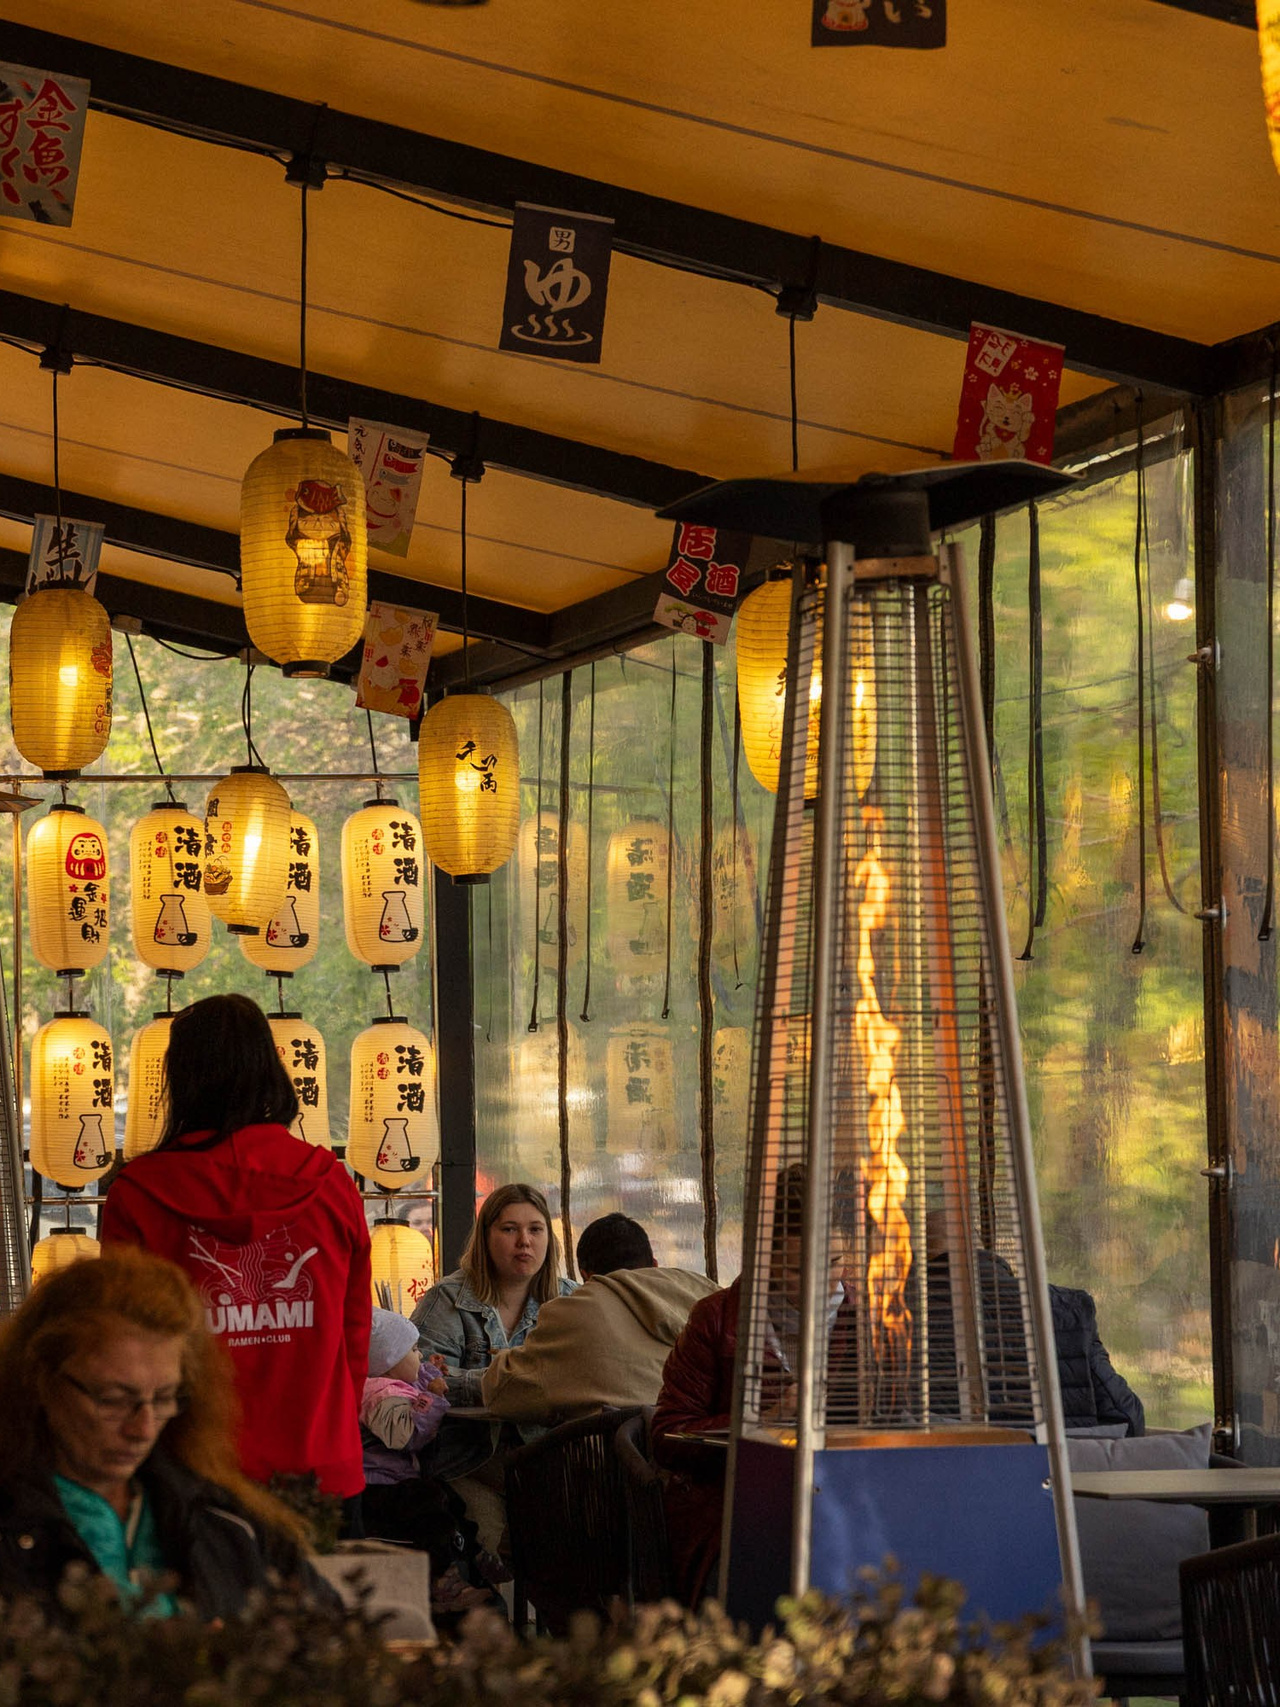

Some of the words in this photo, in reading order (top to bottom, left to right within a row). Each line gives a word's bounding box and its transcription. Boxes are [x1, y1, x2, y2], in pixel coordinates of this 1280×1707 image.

[553, 229, 571, 250] 男
[523, 257, 592, 313] ゆ
[173, 825, 202, 892] 清酒
[388, 821, 419, 887] 清酒
[90, 1040, 112, 1108] 清酒
[291, 1038, 320, 1109] 清酒
[394, 1044, 426, 1113] 清酒
[207, 1300, 314, 1335] UMAMI
[228, 1336, 261, 1348] RAMEN
[266, 1333, 291, 1344] CLUB
